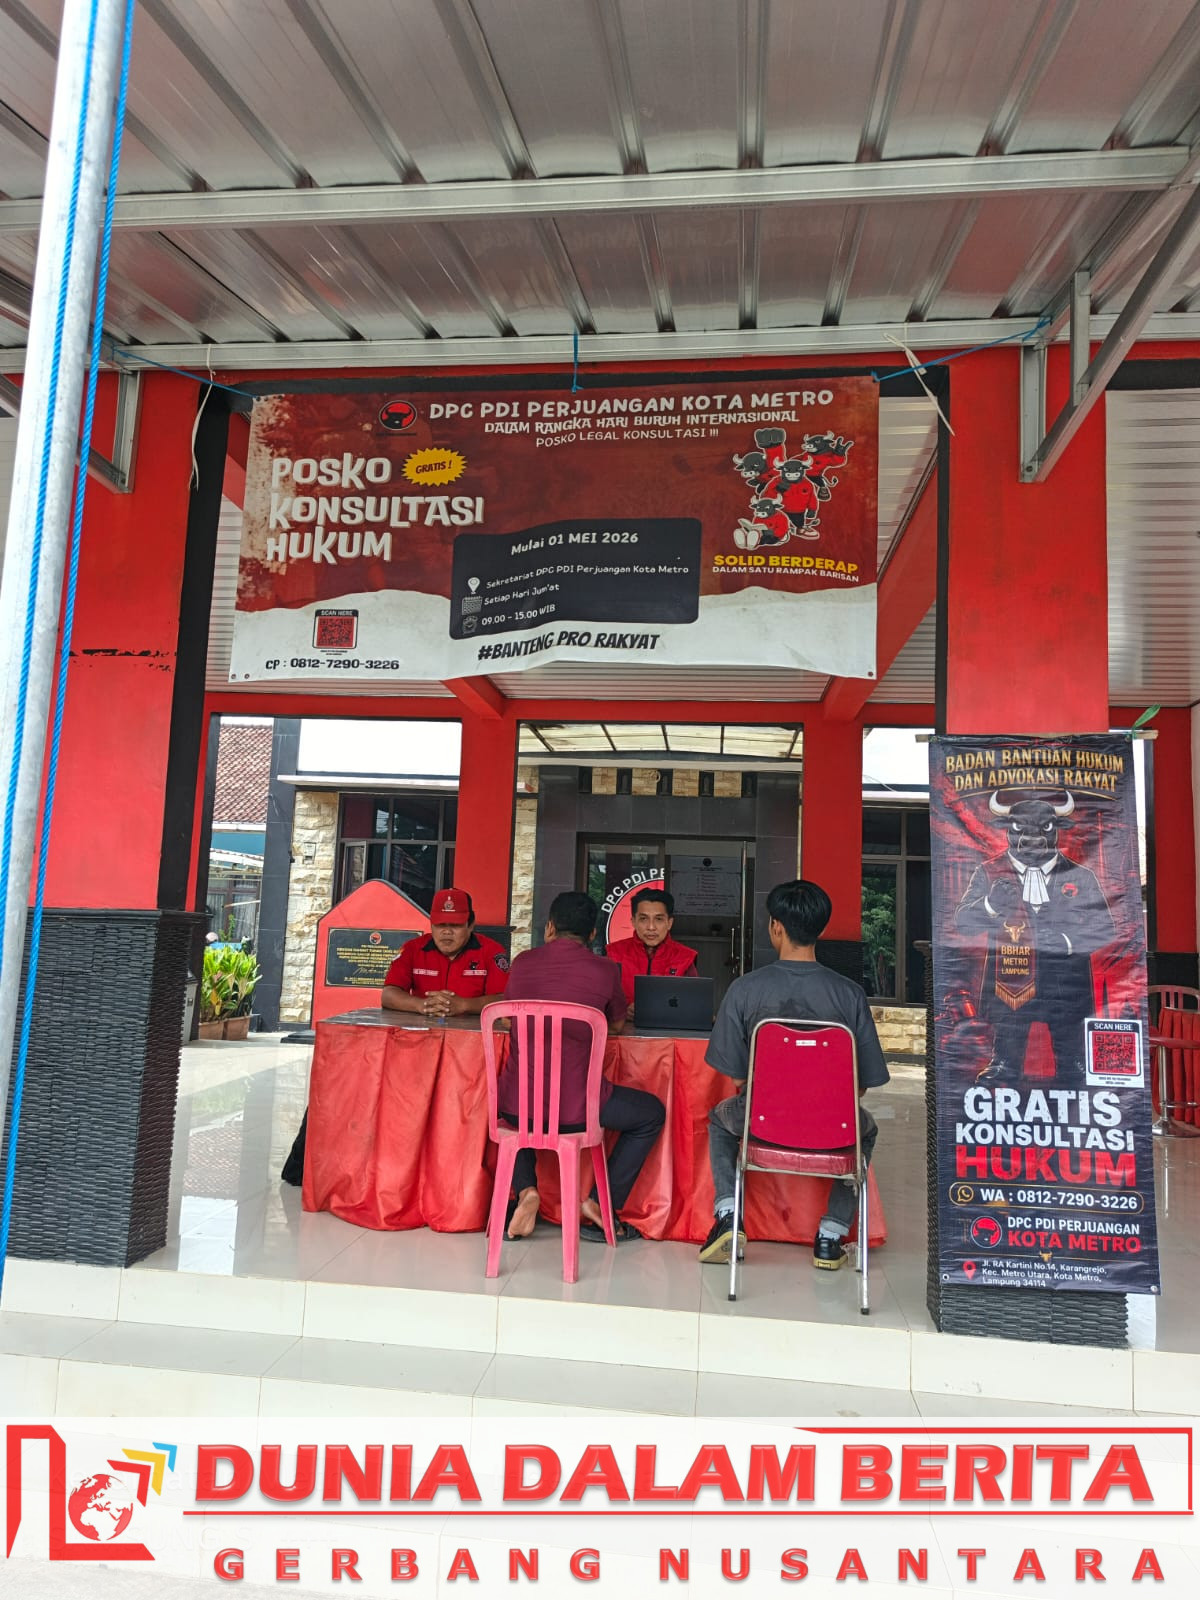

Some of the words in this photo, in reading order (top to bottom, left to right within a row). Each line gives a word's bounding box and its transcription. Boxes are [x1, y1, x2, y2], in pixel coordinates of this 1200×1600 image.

[430, 402, 473, 419] DPC
[480, 401, 520, 418] PDI
[527, 397, 675, 417] PERJUANGAN
[682, 393, 742, 411] KOTA
[751, 390, 834, 408] METRO
[484, 420, 530, 434] DALAM
[535, 417, 591, 434] RANGKA
[596, 416, 629, 428] HARI
[634, 414, 681, 426] BURUH
[686, 410, 799, 424] INTERNASIONAL
[536, 433, 576, 447] POSKO
[580, 431, 619, 441] LEGAL
[623, 428, 706, 440] KONSULTASI
[270, 453, 392, 490] POSKO
[415, 462, 446, 474] GRATIS
[269, 496, 485, 529] KONSULTASI
[267, 527, 393, 565] HUKUM
[510, 537, 545, 556] Mulai
[548, 536, 564, 547] 01
[569, 533, 597, 545] MEI
[601, 532, 639, 544] 2026
[713, 566, 746, 574] DALAM
[749, 566, 773, 574] SATU
[776, 566, 818, 577] RAMPAK
[820, 571, 860, 582] BARISAN
[714, 555, 765, 566] SOLID
[768, 555, 859, 573] BERDERAP
[486, 571, 534, 589] Sekretariat
[536, 568, 554, 577] DPC
[557, 565, 575, 575] PDI
[577, 565, 630, 575] Perjuangan
[633, 565, 656, 574] Kota
[659, 565, 689, 574] Metro
[484, 594, 511, 607] Setiap
[512, 590, 530, 601] Hari
[532, 583, 560, 597] Jum'at
[481, 615, 504, 626] 09.00
[514, 609, 537, 621] 15.00
[540, 604, 556, 615] WIB
[477, 632, 554, 661] #BANTENG
[557, 631, 591, 647] PRO
[594, 632, 660, 649] RAKYAT
[265, 660, 280, 670] CP
[290, 659, 399, 671] 0812-7290-3226
[946, 752, 996, 773] BADAN
[1001, 749, 1072, 767] BANTUAN
[1076, 751, 1124, 773] HUKUM
[955, 772, 983, 791] DAN
[988, 767, 1059, 787] ADVOKASI
[1063, 768, 1118, 792] RAKYAT
[601, 887, 624, 913] DPC
[622, 871, 647, 889] PDI
[1001, 944, 1030, 956] BBHAR
[1001, 967, 1030, 976] LAMPUNG
[1003, 957, 1028, 967] METRO
[963, 1086, 1122, 1127] GRATIS
[955, 1122, 1135, 1151] KONSULTASI
[955, 1145, 1136, 1187] HUKUM
[981, 1188, 1004, 1201] WA
[1017, 1191, 1138, 1210] 0812-7290-3226
[1007, 1216, 1032, 1228] DPC
[1035, 1218, 1055, 1230] PDI
[1059, 1219, 1140, 1235] PERJUANGAN
[1008, 1230, 1062, 1248] KOTA
[1068, 1234, 1141, 1253] METRO
[1006, 1261, 1032, 1269] Kartini
[1054, 1272, 1071, 1280] Kota
[983, 1277, 1021, 1287] Lampung
